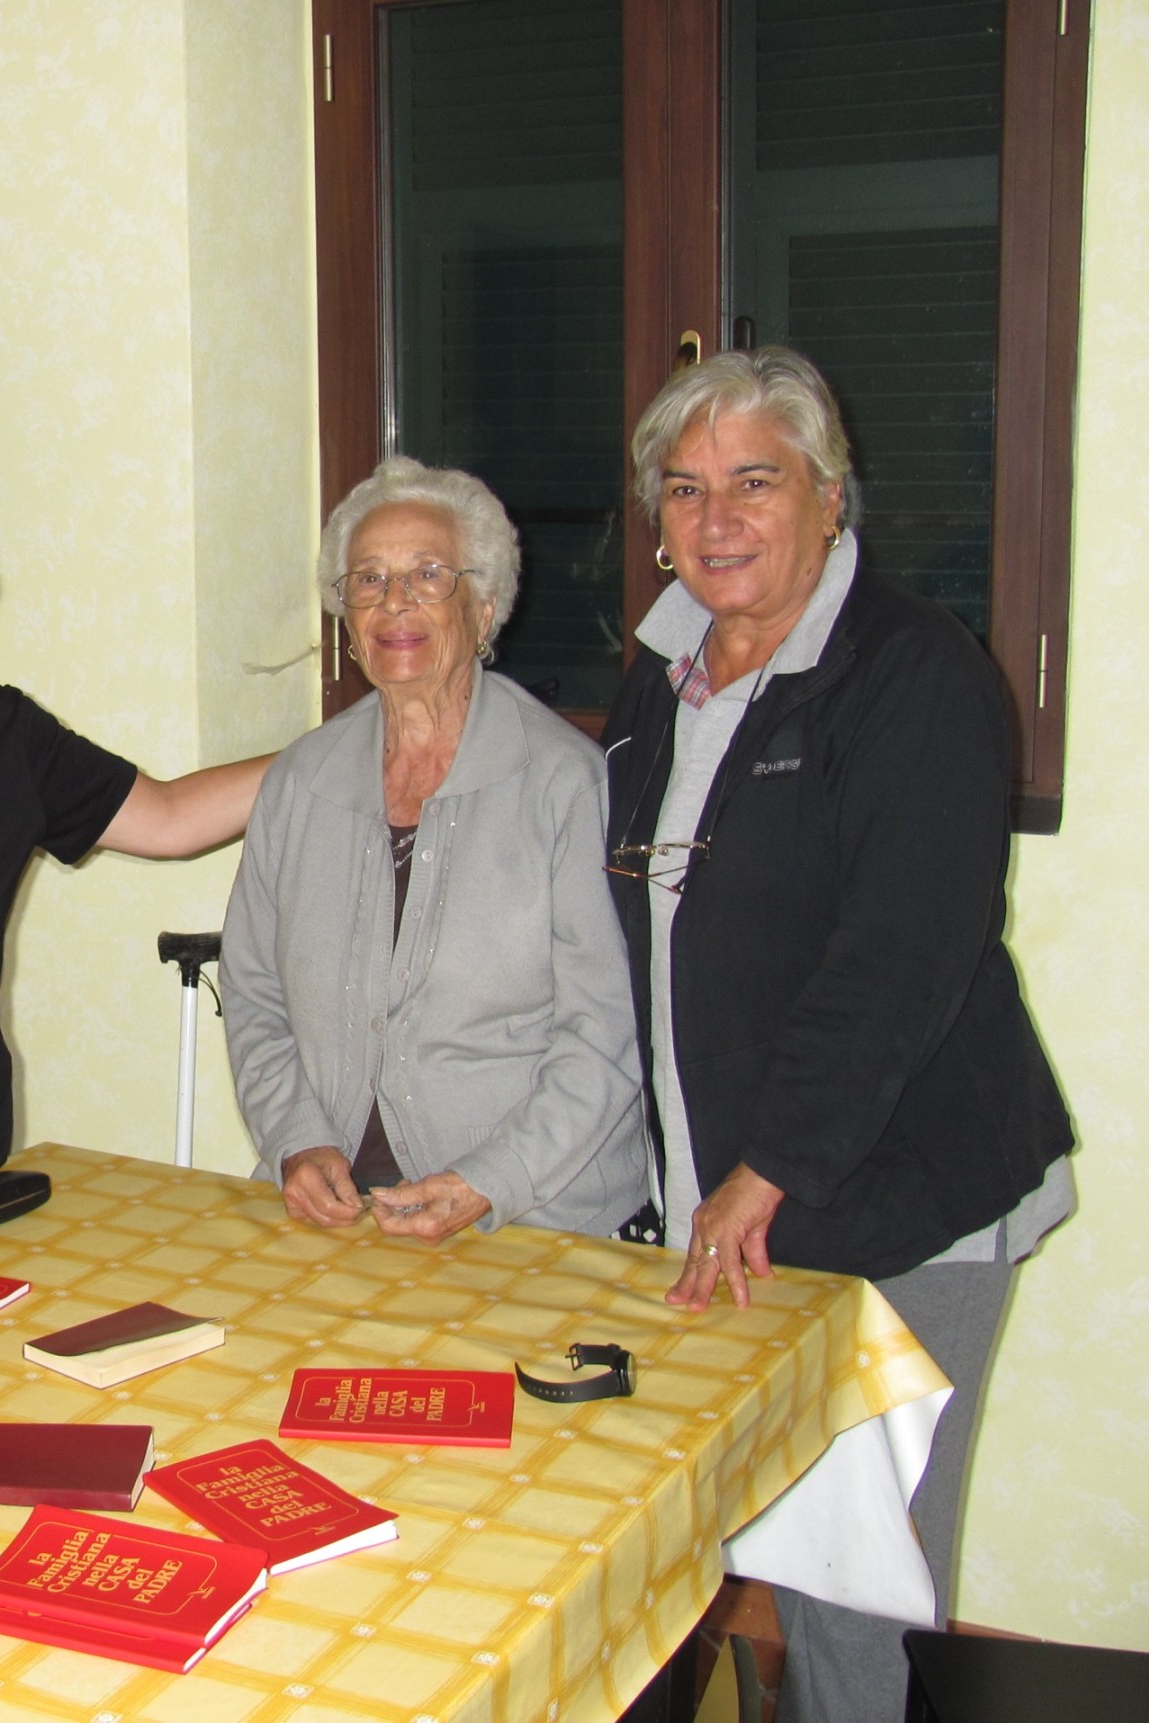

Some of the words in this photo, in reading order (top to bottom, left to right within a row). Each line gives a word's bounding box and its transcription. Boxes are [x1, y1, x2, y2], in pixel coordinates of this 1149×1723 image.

[315, 1397, 331, 1406] la
[329, 1379, 356, 1422] Famiglia
[349, 1377, 372, 1423] Cristiana
[372, 1391, 389, 1415] nella
[389, 1390, 408, 1417] CASA
[410, 1397, 426, 1412] del
[426, 1387, 446, 1421] PADRE
[195, 1464, 285, 1491] Famiglia
[219, 1466, 242, 1475] la
[205, 1471, 300, 1499] Cristiana
[238, 1484, 290, 1502] nella
[245, 1490, 304, 1509] CASA
[270, 1500, 304, 1514] del
[260, 1502, 332, 1527] PADRE
[27, 1531, 89, 1588] Famiglia
[28, 1552, 52, 1566] la
[47, 1532, 111, 1593] Cristiana
[82, 1554, 119, 1586] nella
[98, 1557, 140, 1592] CASA
[128, 1568, 154, 1590] del
[132, 1559, 183, 1603] PADRE
